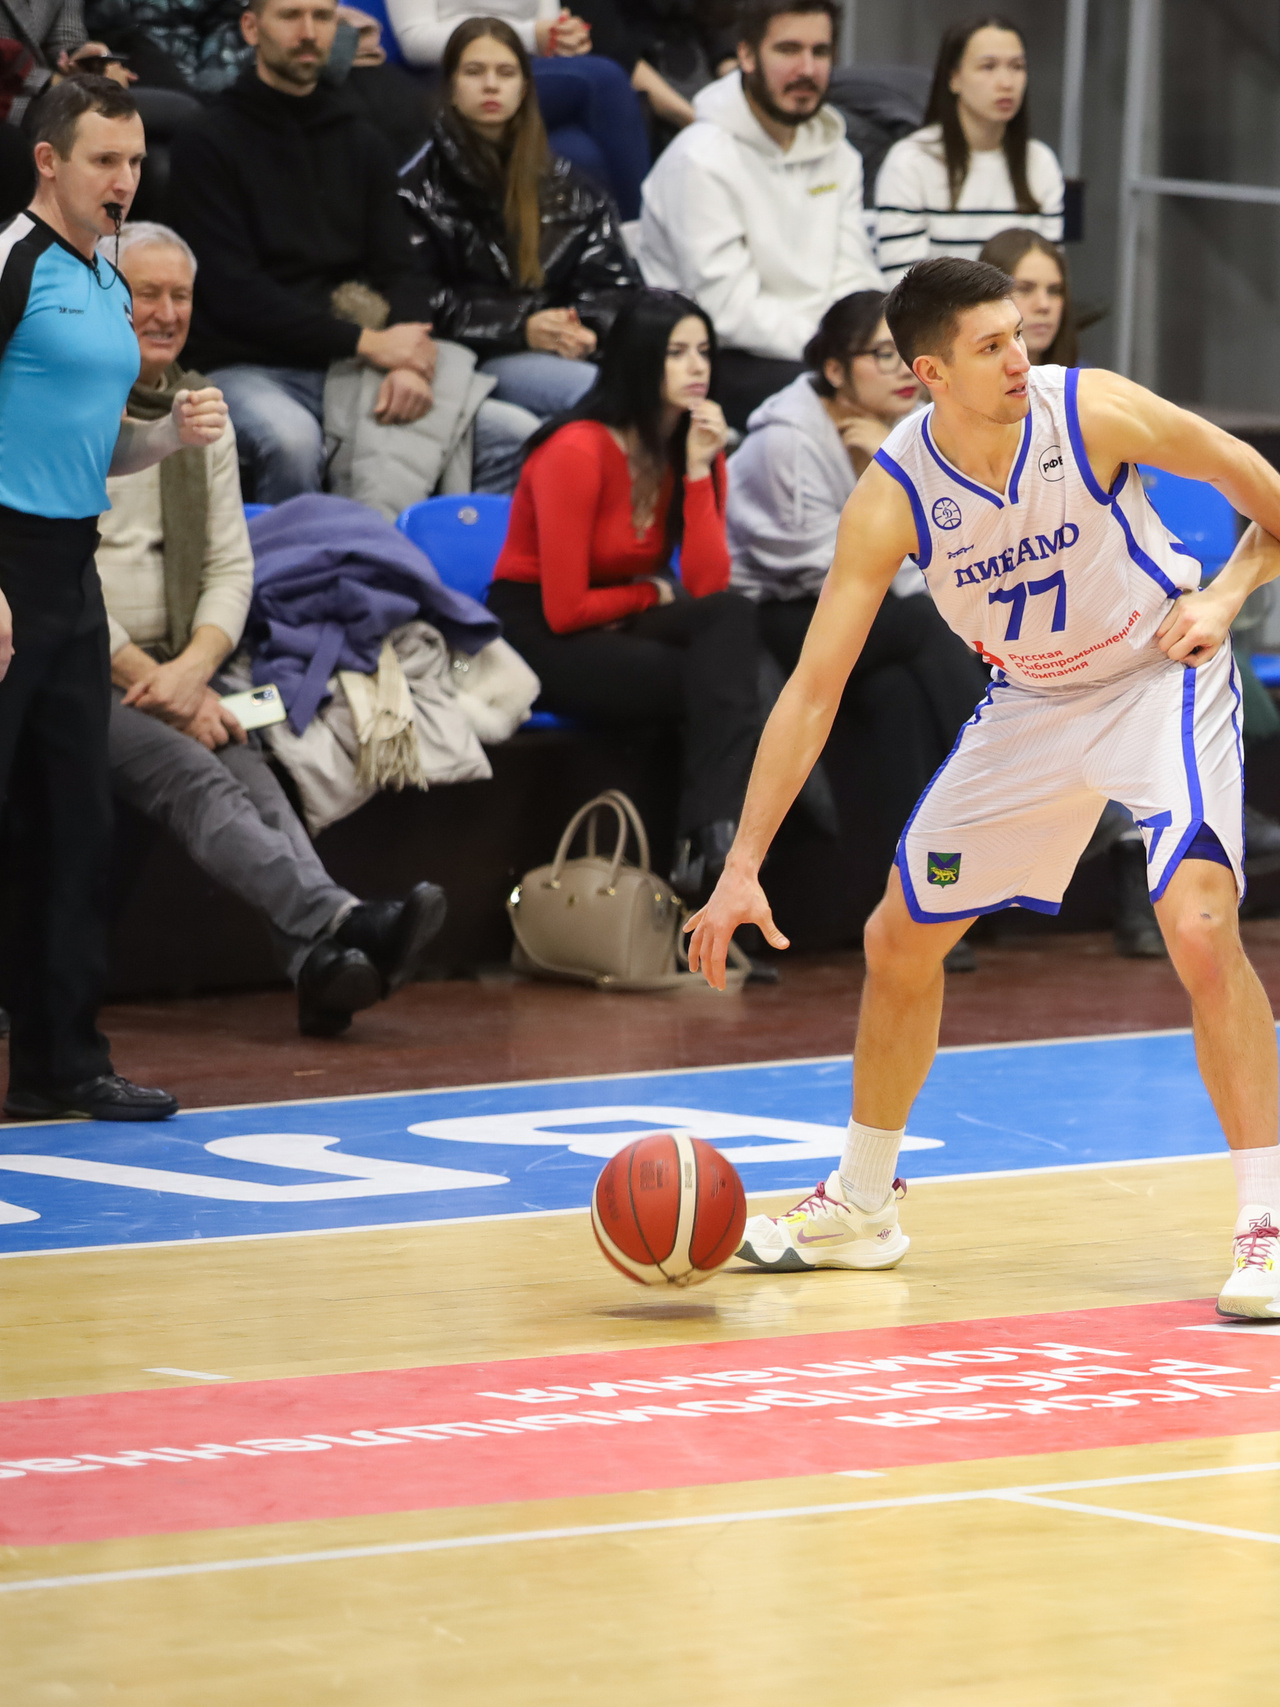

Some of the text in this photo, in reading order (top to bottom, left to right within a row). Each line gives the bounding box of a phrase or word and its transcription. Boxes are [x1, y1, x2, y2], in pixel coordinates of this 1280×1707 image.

[988, 569, 1067, 641] 77
[1008, 650, 1063, 662] Русская
[1022, 661, 1090, 680] Компания
[475, 1342, 1133, 1404] Компания
